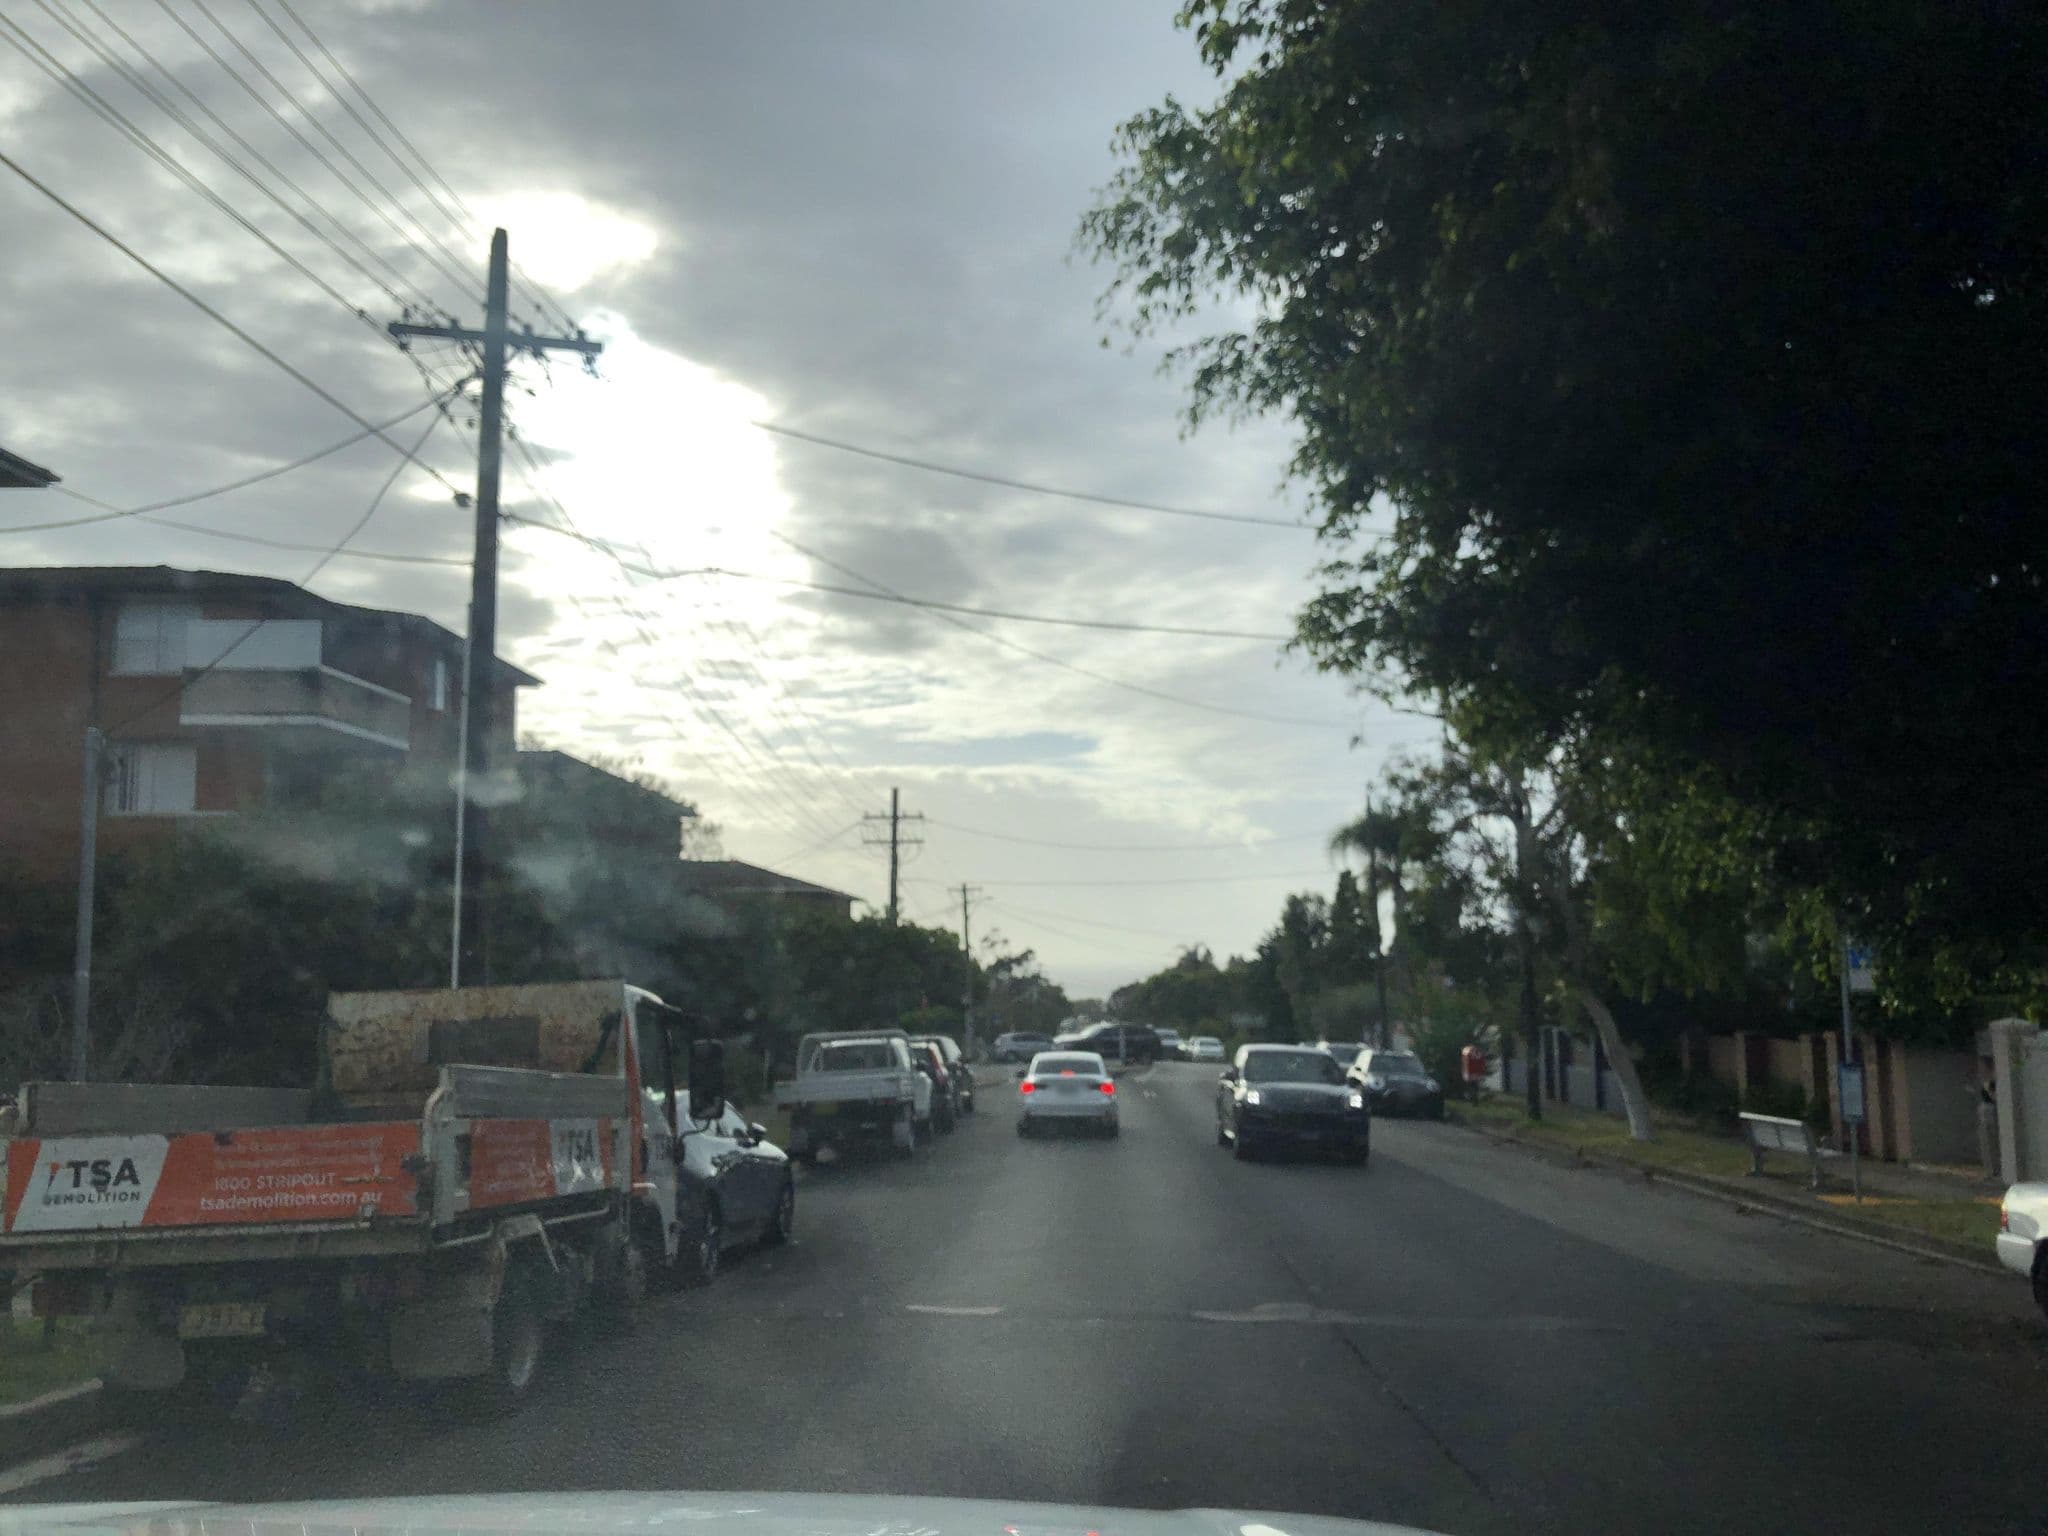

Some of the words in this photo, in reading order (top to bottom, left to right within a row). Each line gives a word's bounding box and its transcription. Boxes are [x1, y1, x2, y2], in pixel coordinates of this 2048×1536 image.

[65, 1157, 141, 1188] TSA
[215, 1176, 251, 1191] 1800
[257, 1172, 336, 1189] STRIPOUT
[42, 1190, 141, 1206] DEMOLITION
[200, 1190, 383, 1211] tsademolition.comau
